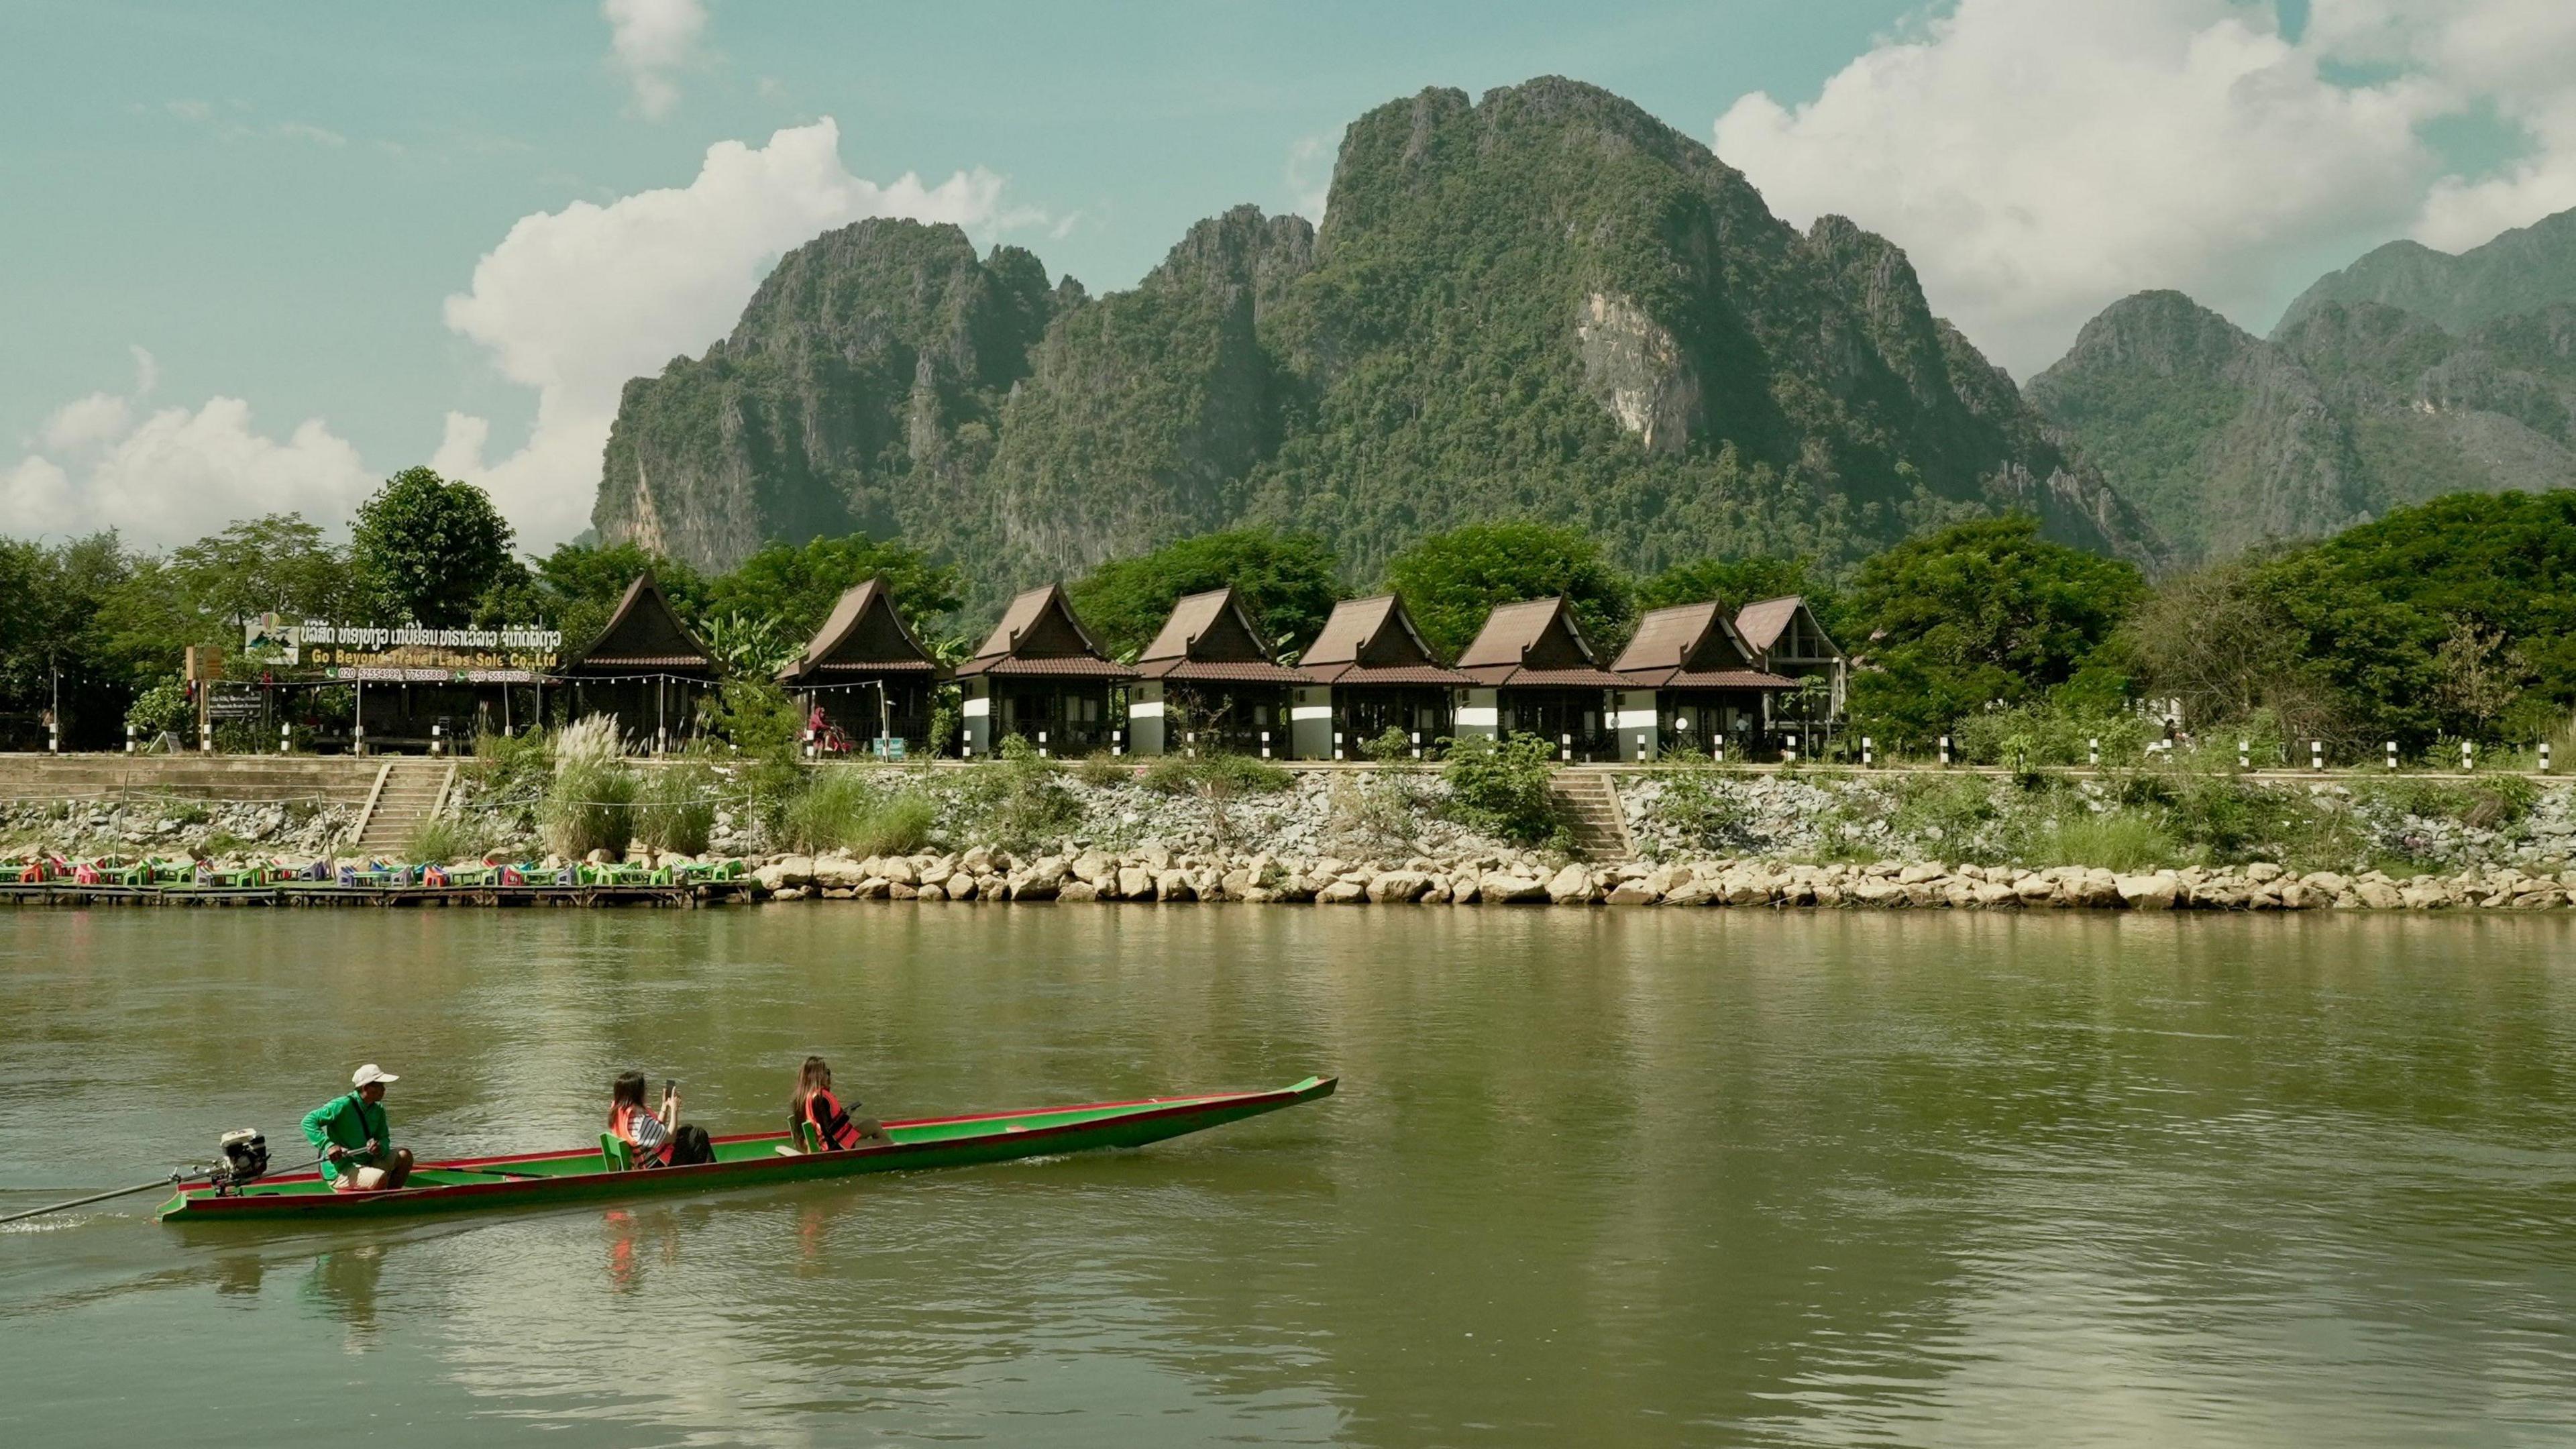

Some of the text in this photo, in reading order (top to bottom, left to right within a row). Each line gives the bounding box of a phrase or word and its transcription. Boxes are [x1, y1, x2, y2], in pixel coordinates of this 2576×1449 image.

[311, 648, 330, 663] Go
[335, 649, 385, 667] Beyond
[391, 650, 433, 666] Travel
[437, 651, 470, 667] Laos
[476, 652, 503, 667] Sole
[338, 667, 356, 678] 020
[405, 669, 447, 680] 77555888
[468, 671, 486, 682] 020
